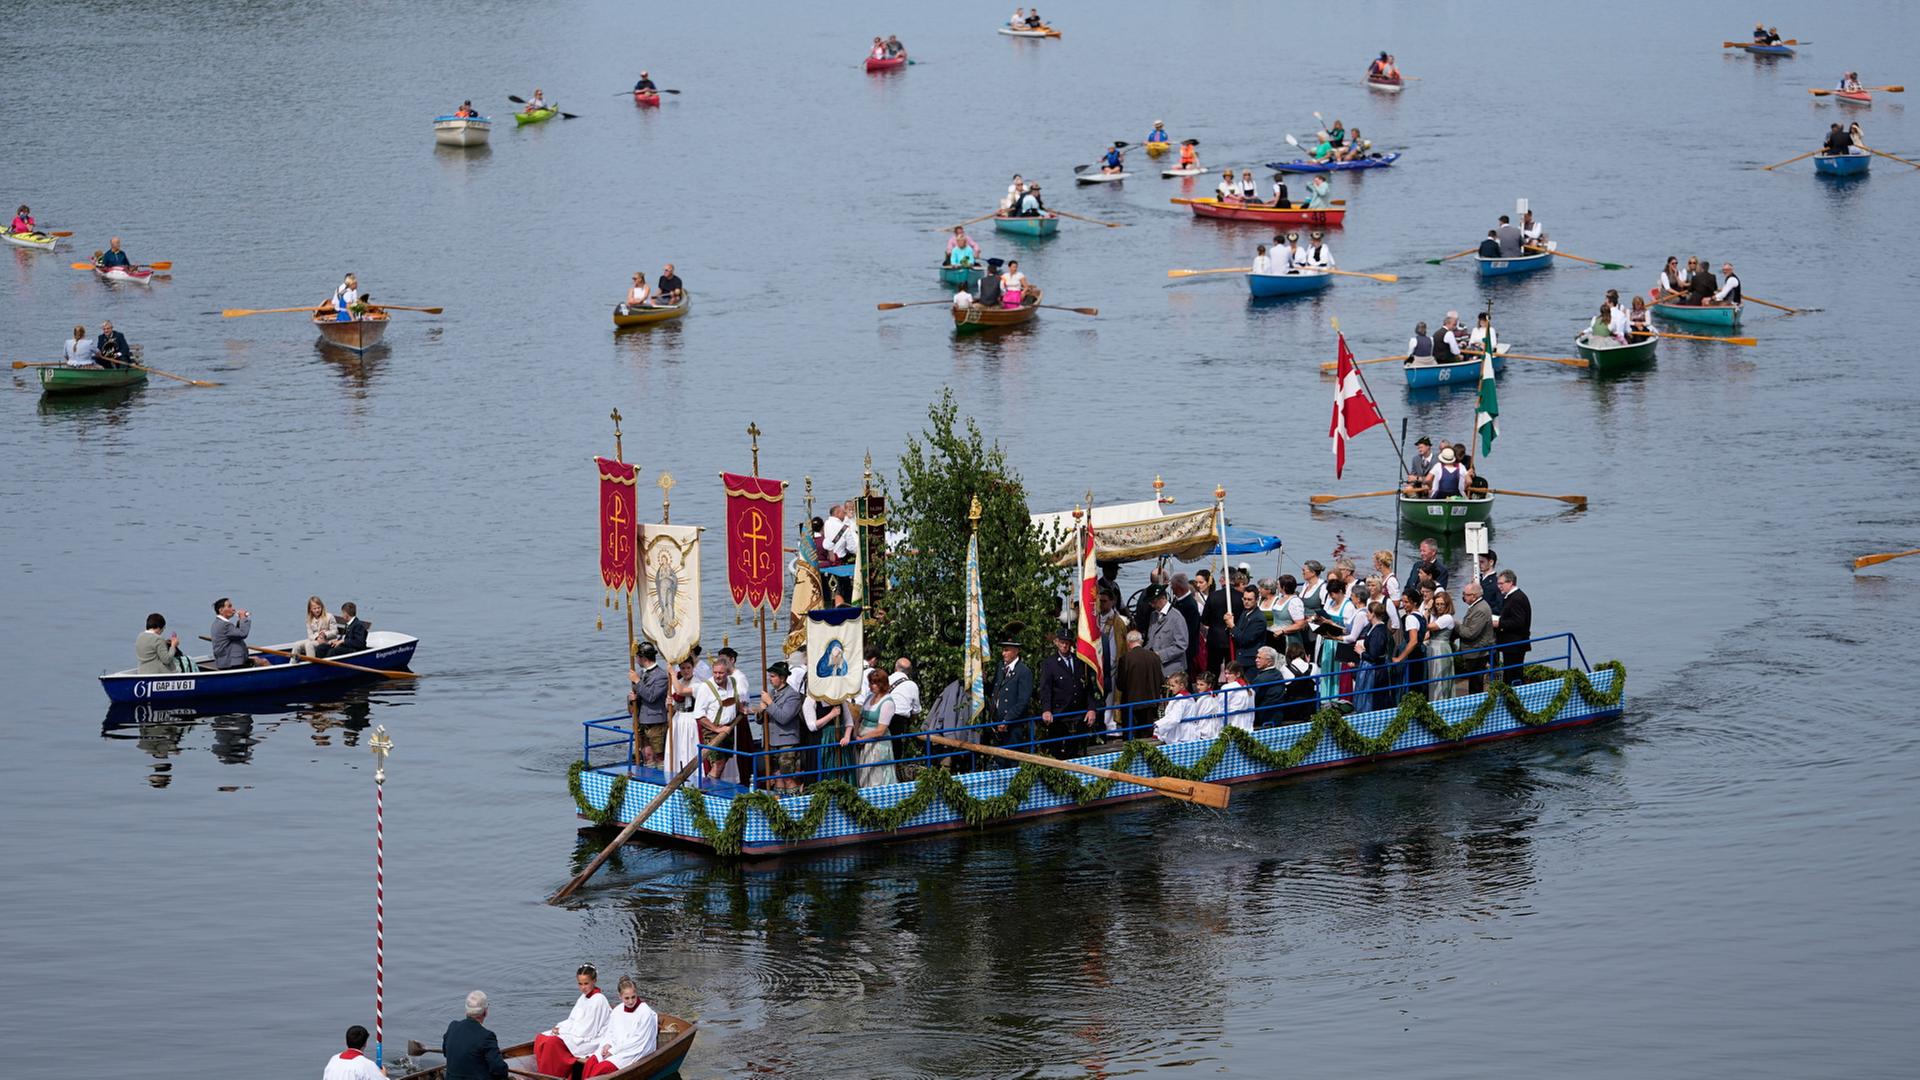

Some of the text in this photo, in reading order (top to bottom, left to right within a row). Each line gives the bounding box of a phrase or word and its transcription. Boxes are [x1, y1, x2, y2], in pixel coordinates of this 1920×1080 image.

[1438, 368, 1452, 382] 66
[134, 680, 152, 698] 61
[156, 681, 170, 691] GAP
